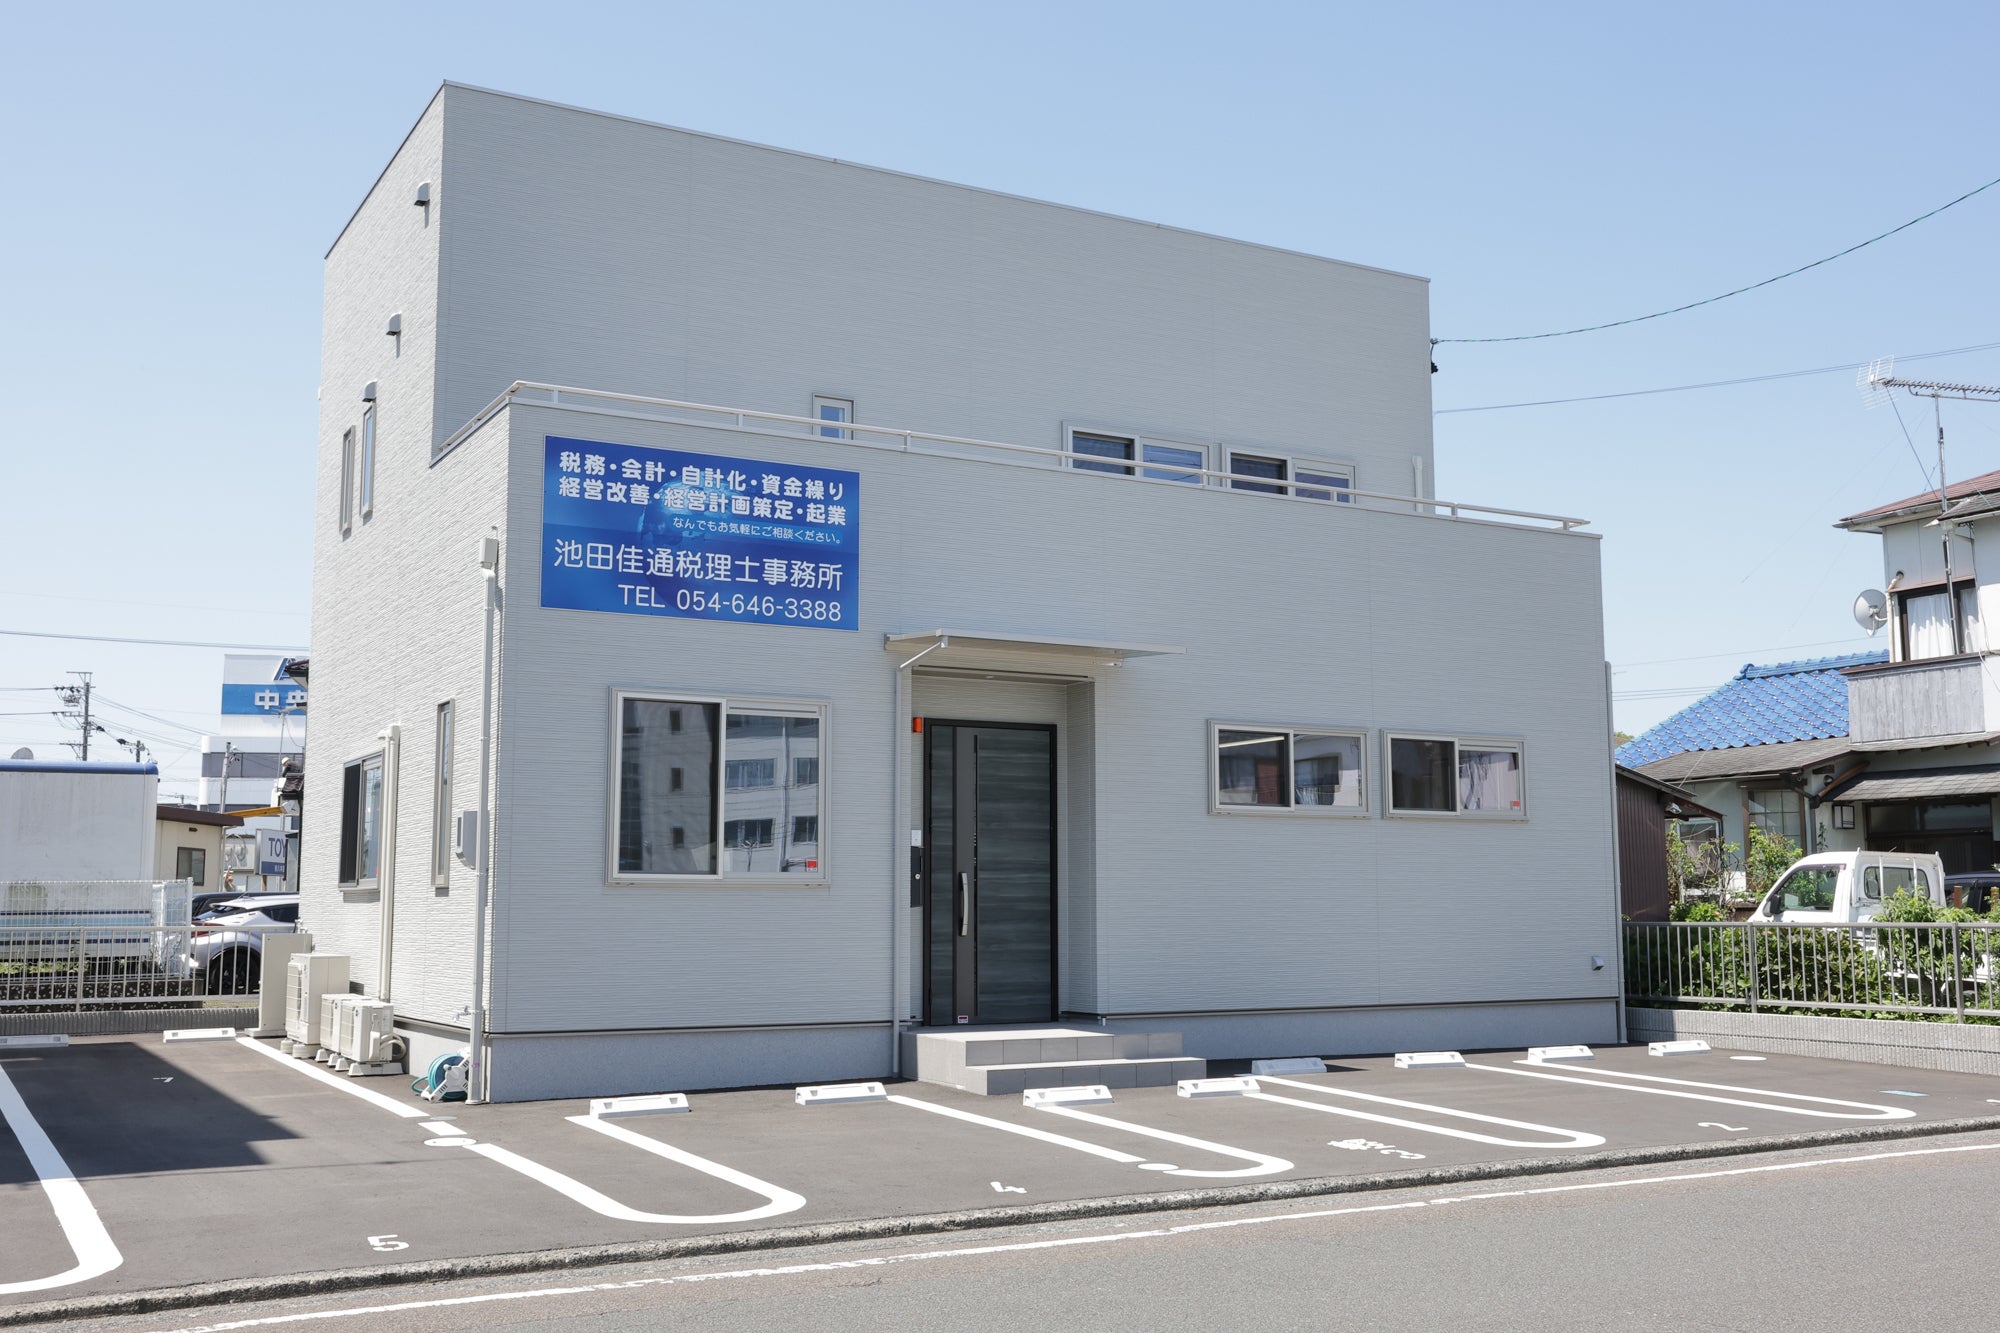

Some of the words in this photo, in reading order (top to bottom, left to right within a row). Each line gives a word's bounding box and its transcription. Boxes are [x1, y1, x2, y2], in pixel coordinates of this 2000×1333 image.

[558, 450, 845, 501] 税務・会計・自計化・資金繰り
[558, 475, 847, 526] 経営改善・経営計画策定・起業
[672, 516, 841, 545] なんでもお気軽にご相談ください。
[553, 538, 844, 591] 池田佳通税理士事務所
[617, 584, 666, 608] TEL
[676, 589, 842, 622] 054-646-3388
[1696, 1121, 1749, 1130] 2
[990, 1181, 1027, 1193] 4
[367, 1234, 410, 1252] 5
